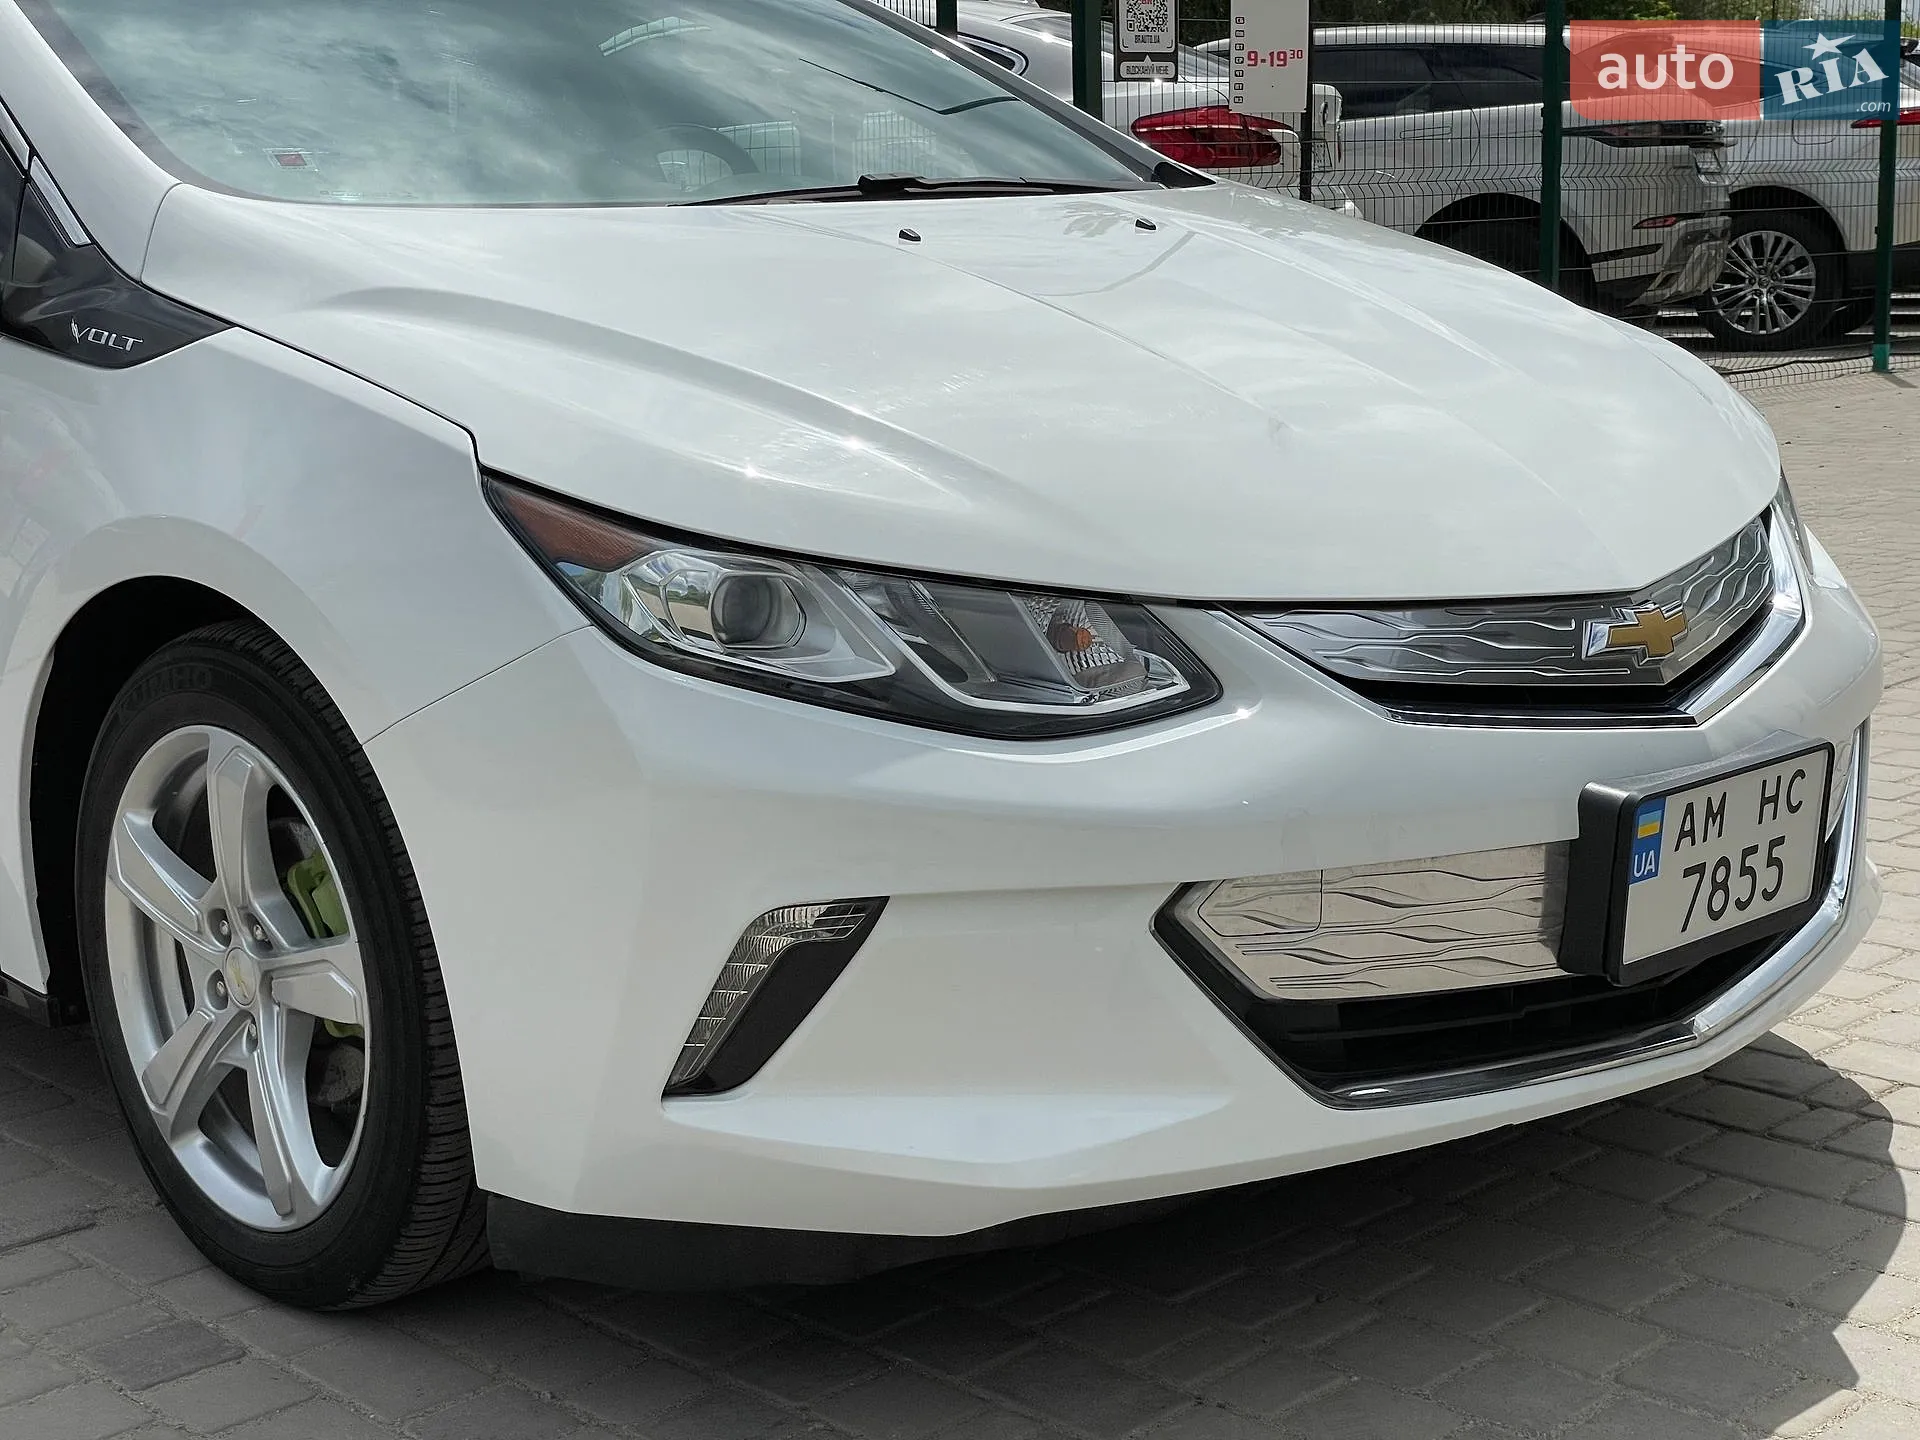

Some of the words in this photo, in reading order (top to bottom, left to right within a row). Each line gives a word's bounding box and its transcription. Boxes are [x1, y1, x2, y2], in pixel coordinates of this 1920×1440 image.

[70, 318, 143, 351] VOLT
[1674, 792, 1727, 852] AM
[1758, 769, 1806, 825] HC
[1633, 851, 1655, 878] UA
[1681, 835, 1785, 933] 7855
